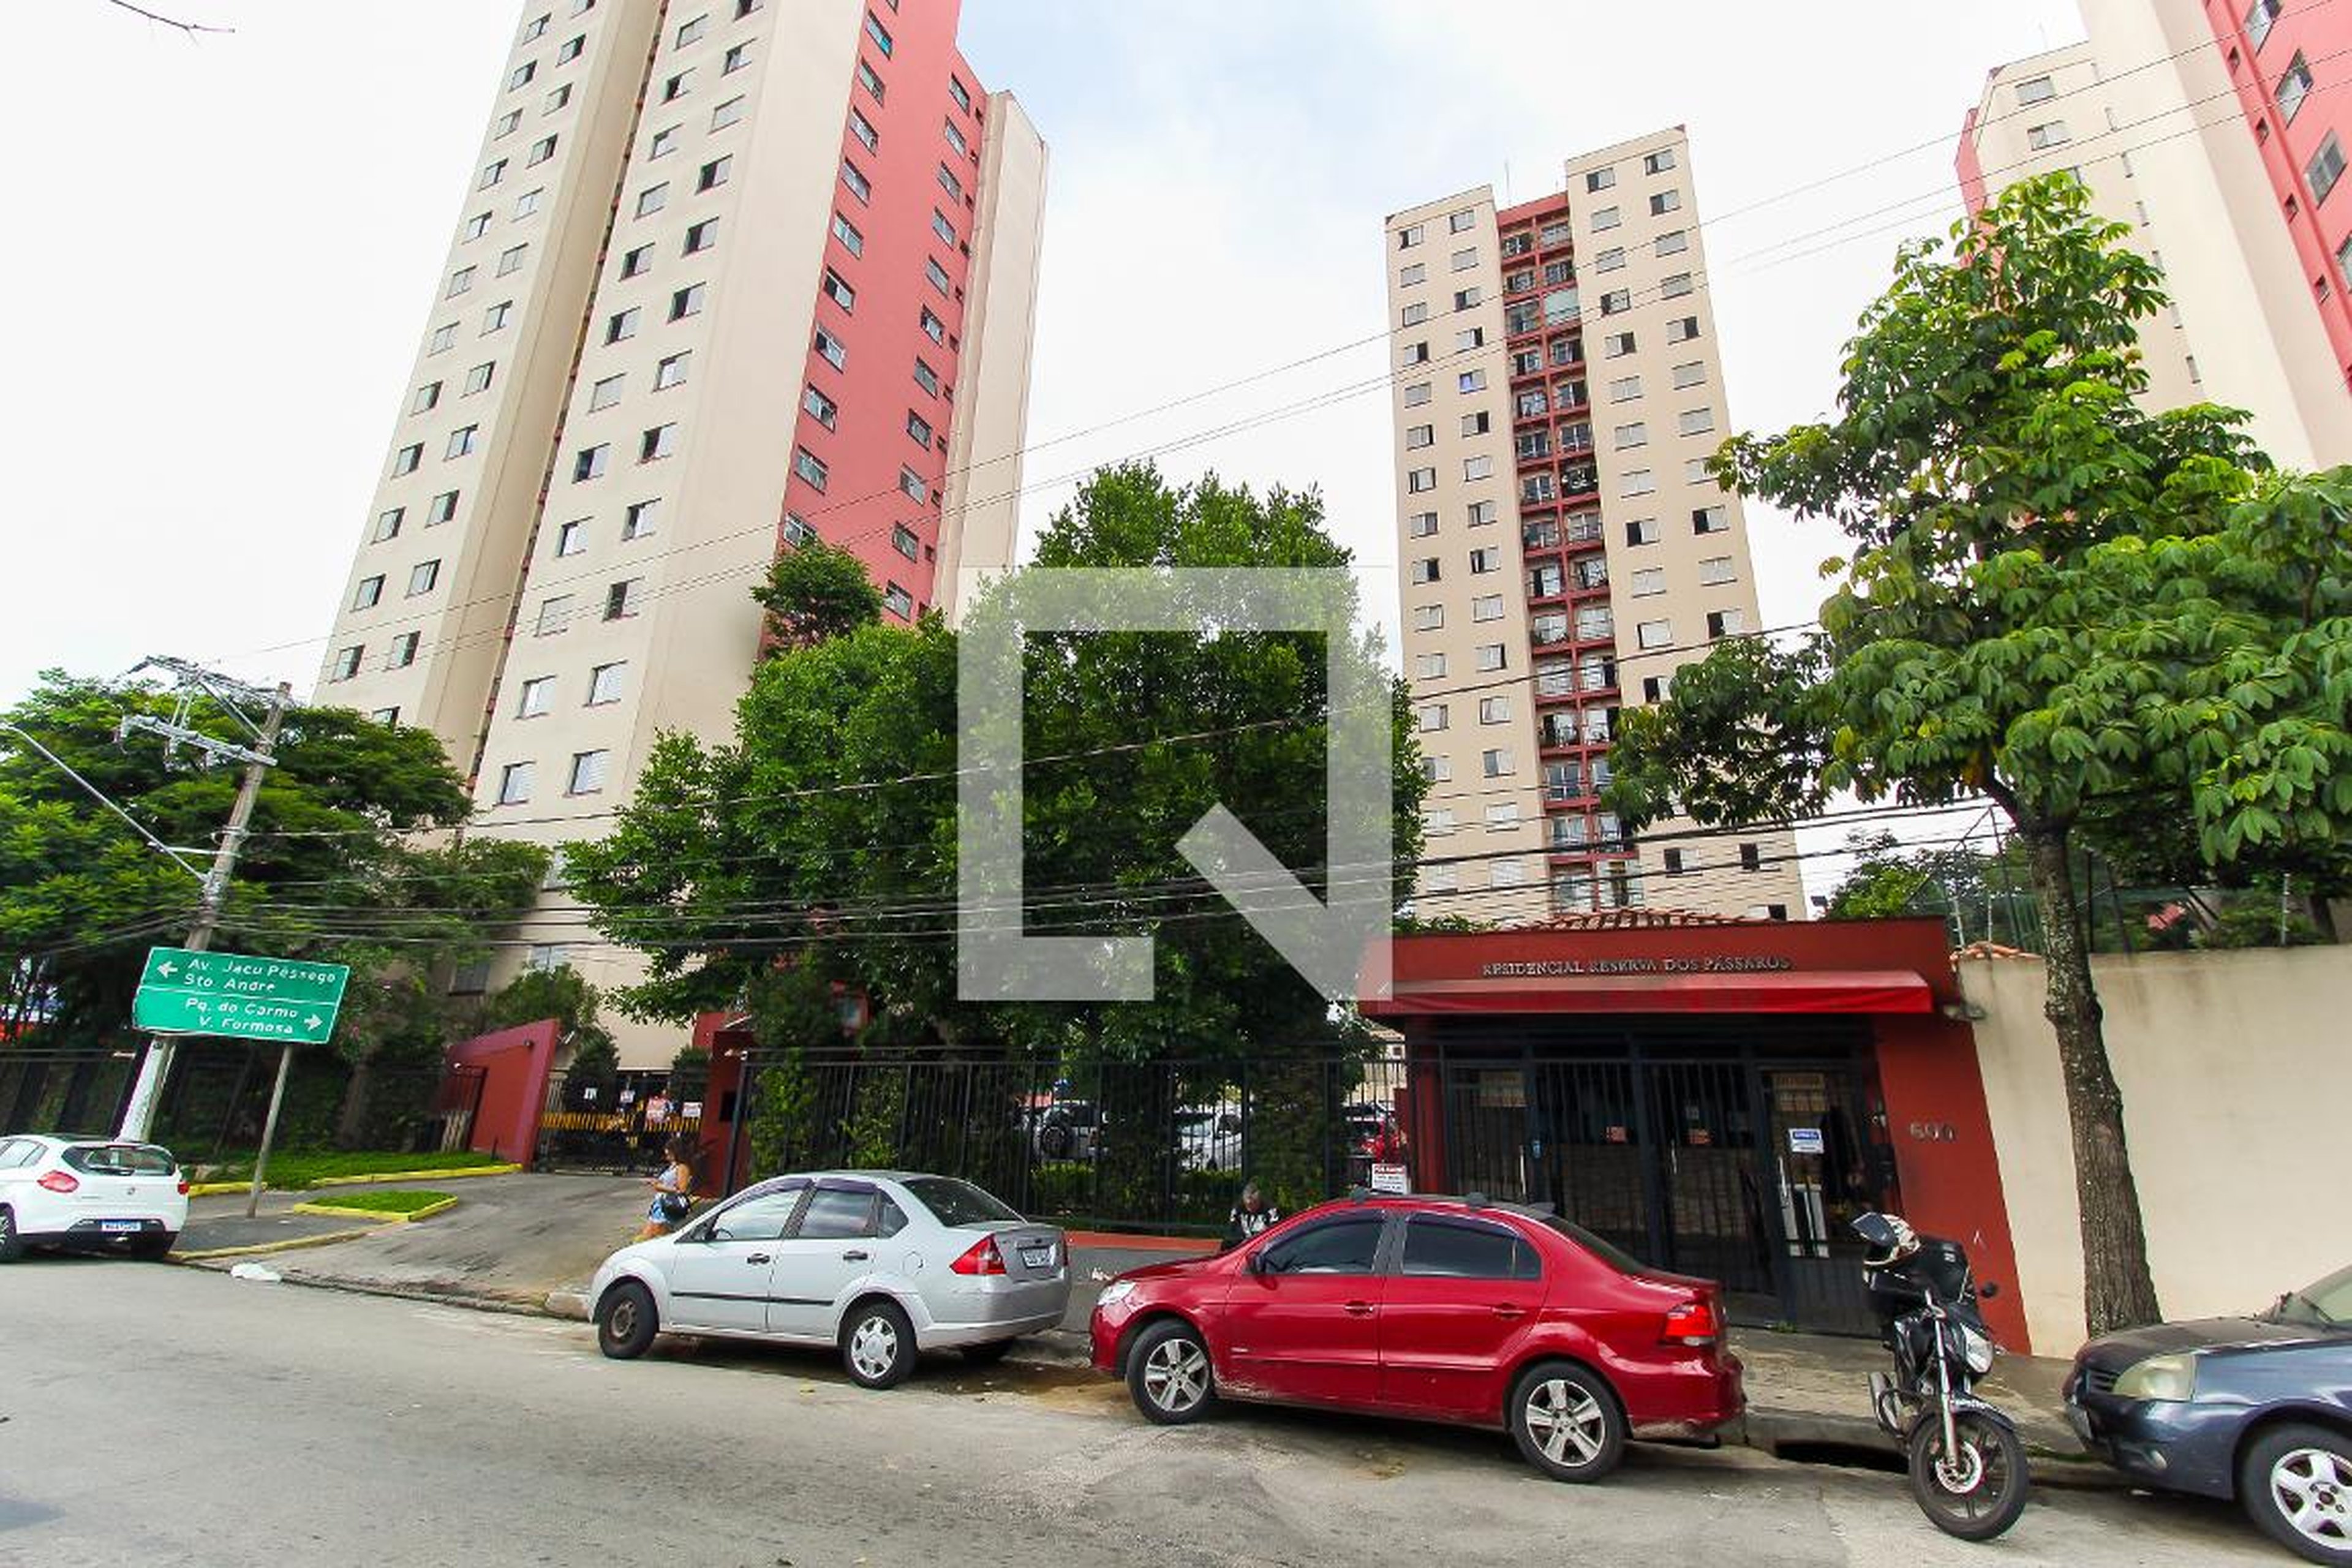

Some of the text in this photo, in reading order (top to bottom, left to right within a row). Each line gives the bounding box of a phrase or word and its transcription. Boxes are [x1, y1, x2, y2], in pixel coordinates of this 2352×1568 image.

[188, 959, 213, 971] Av.
[1483, 962, 1585, 976] RESIDENCIAL
[1664, 958, 1699, 971] DOS
[219, 1002, 238, 1013] do
[245, 1003, 298, 1017] Carmo
[199, 1016, 293, 1034] V. Formosa
